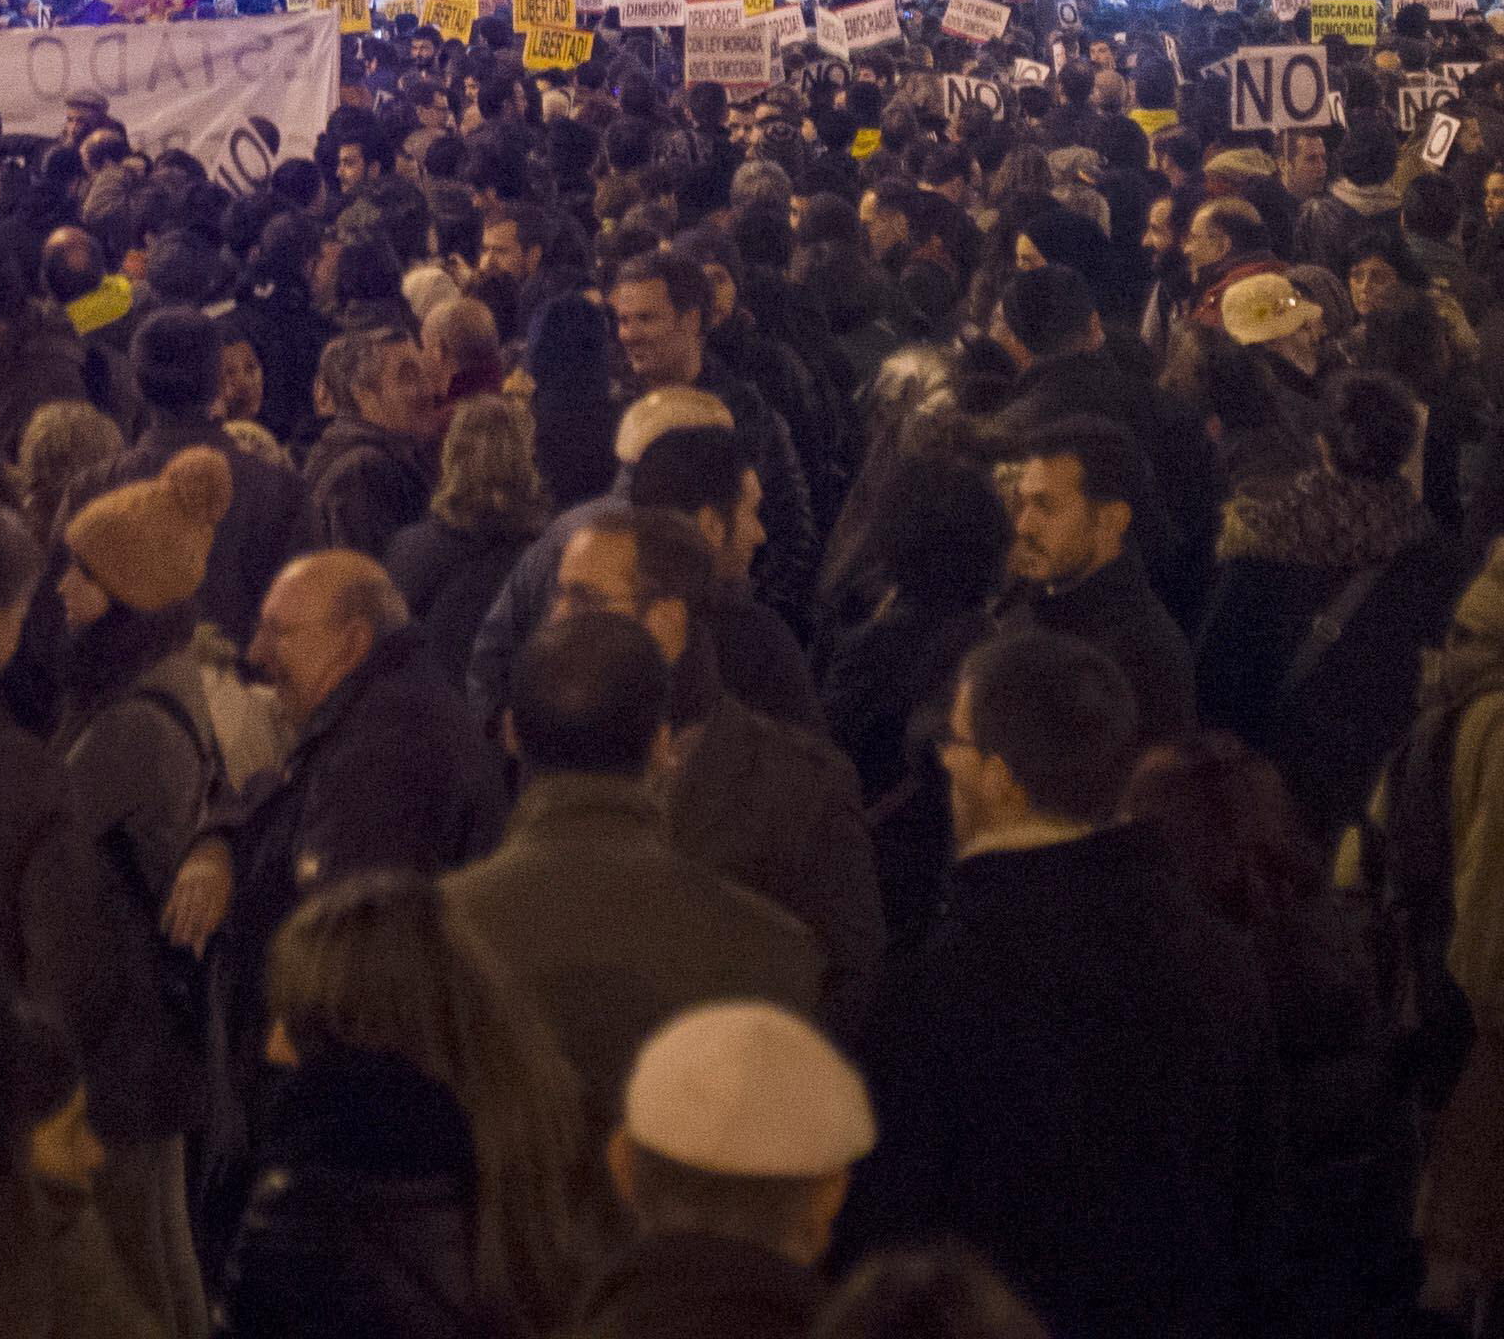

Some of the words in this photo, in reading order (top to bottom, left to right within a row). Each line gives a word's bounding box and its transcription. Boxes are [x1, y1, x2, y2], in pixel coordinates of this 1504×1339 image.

[1312, 3, 1359, 18] RESCATAR
[1361, 4, 1374, 19] LA
[1313, 22, 1374, 37] DEMOCRACIA
[948, 77, 1003, 115] NO
[1236, 53, 1325, 124] NO
[1403, 88, 1458, 130] NO
